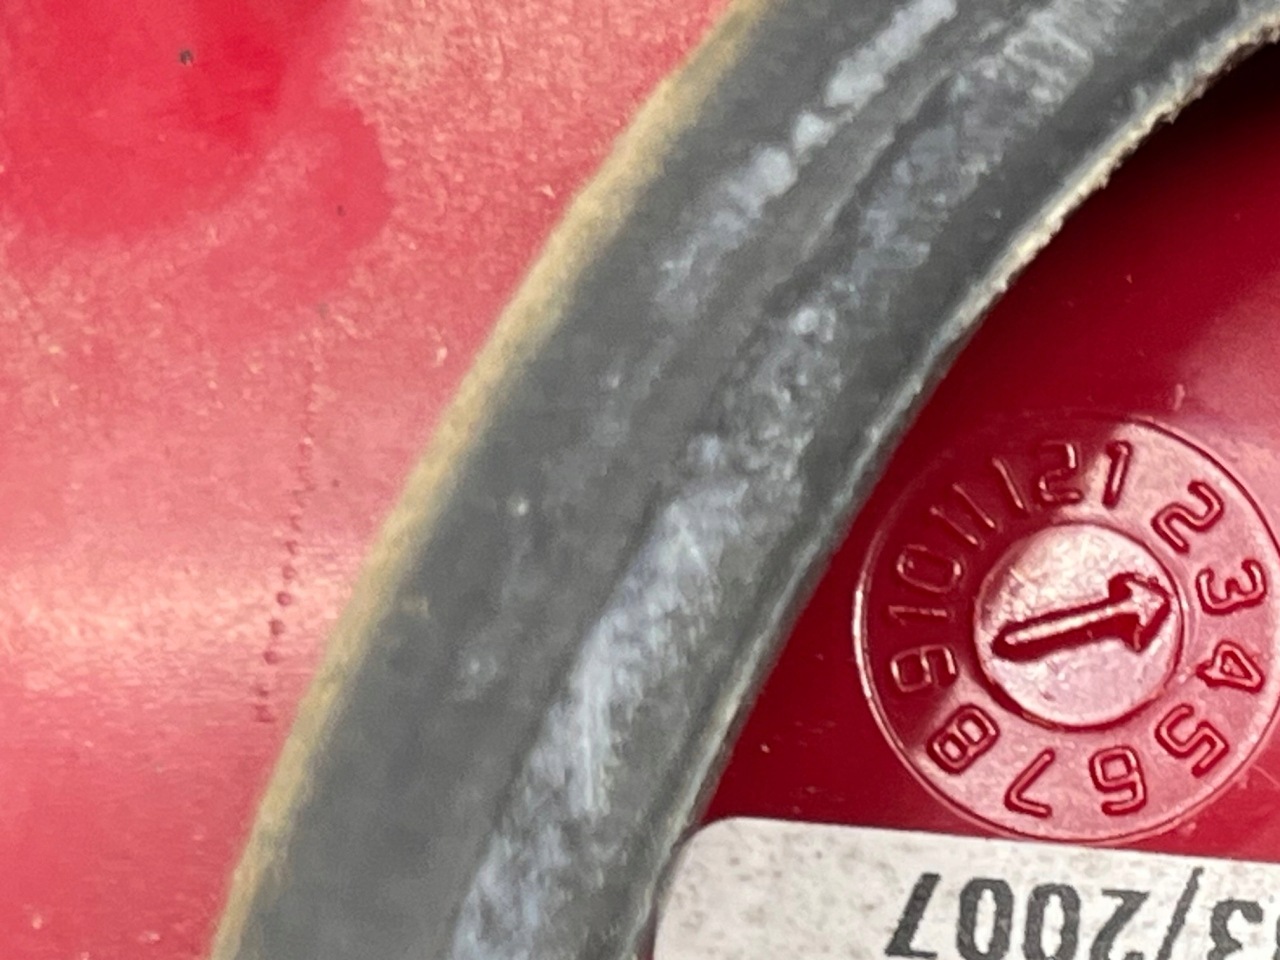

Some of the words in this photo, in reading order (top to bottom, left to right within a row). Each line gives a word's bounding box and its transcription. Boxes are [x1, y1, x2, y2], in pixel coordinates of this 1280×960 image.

[992, 442, 1082, 511] 12
[1103, 441, 1132, 508] 1
[1152, 481, 1224, 553] 2
[888, 544, 962, 625] 10
[1196, 559, 1266, 615] 3
[891, 644, 958, 693] 9
[1197, 640, 1264, 693] 4
[927, 703, 1000, 774] 8
[1155, 703, 1228, 777] 5
[1005, 748, 1055, 818] 7
[1089, 745, 1146, 815] 6
